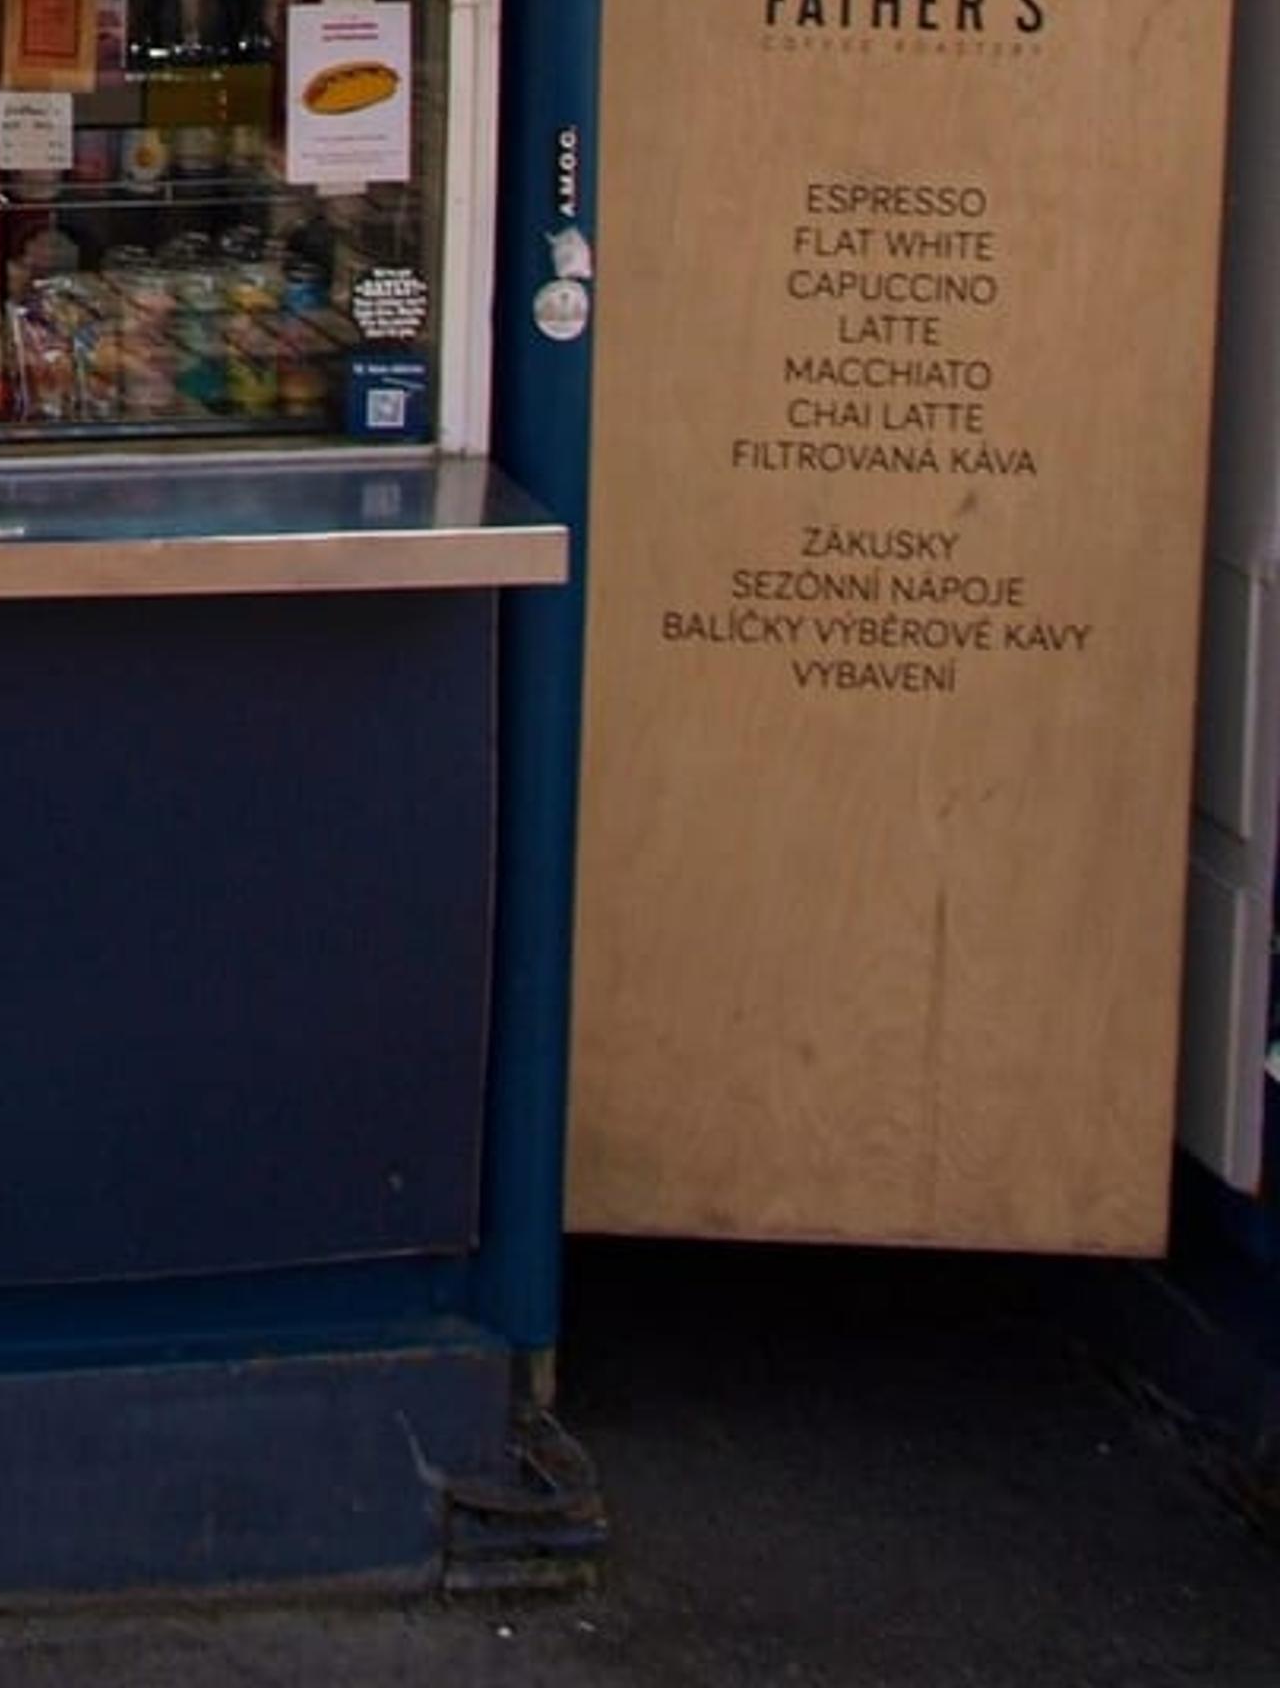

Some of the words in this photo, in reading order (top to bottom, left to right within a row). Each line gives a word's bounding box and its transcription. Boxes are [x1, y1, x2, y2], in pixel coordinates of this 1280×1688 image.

[807, 184, 987, 218] ESPRESSO
[793, 226, 874, 257] FLAT
[885, 229, 994, 261] WHITE
[786, 269, 998, 305] CAPUCCINO
[838, 315, 941, 347] LATTE
[784, 356, 992, 391] MACCHIATO
[786, 398, 871, 429] CHAI
[883, 402, 984, 433] LATTE
[732, 438, 939, 473] FILTROVANÁ
[951, 441, 1038, 477] KÁVA
[801, 524, 959, 561] ZÁKUSKY
[731, 567, 880, 602] SEZÓNNÍ
[891, 570, 1025, 607] NÁPOJE
[662, 605, 803, 644] BALÍČKY
[1004, 616, 1093, 652] KÁVY
[792, 656, 957, 693] VYBAVENÍ
